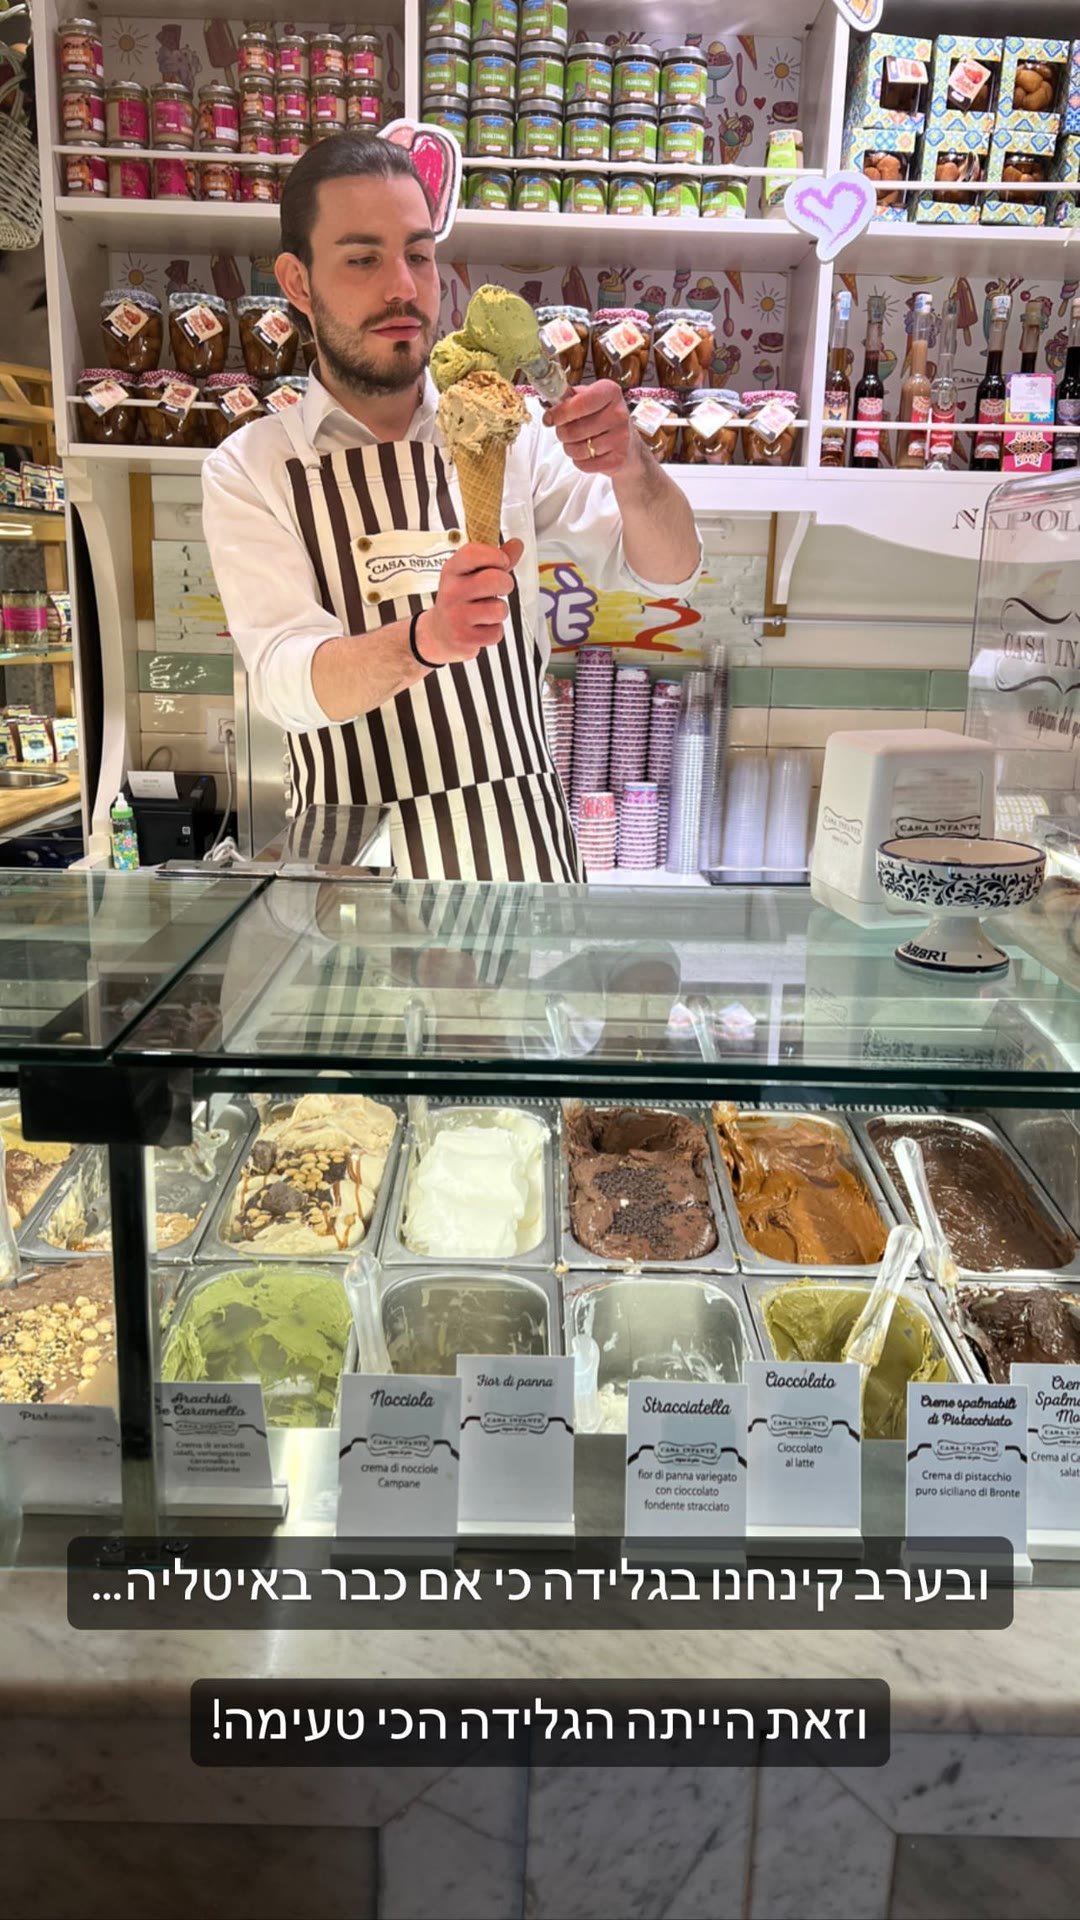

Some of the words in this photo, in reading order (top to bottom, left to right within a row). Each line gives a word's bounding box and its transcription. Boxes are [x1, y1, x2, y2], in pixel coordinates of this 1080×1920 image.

[372, 559, 406, 575] CASA
[1003, 633, 1046, 664] CASA
[1055, 638, 1080, 669] IN
[476, 1374, 501, 1387] Fior
[503, 1374, 514, 1387] di
[516, 1378, 554, 1391] panna
[765, 1370, 837, 1389] Cioccolato
[171, 1392, 232, 1404] Arachidi
[370, 1389, 435, 1408] Nocciola
[173, 1405, 246, 1416] Caramello
[642, 1396, 732, 1416] Stracciatella
[927, 1412, 939, 1425] di
[941, 1412, 1013, 1426] Pistacchiato
[777, 1442, 823, 1454] Cioccolato
[785, 1458, 794, 1468] al
[795, 1458, 815, 1468] latte
[1031, 1451, 1060, 1462] Crema
[1061, 1451, 1070, 1462] al
[361, 1464, 389, 1473] crema
[390, 1463, 400, 1473] di
[401, 1464, 439, 1474] nocciole
[638, 1469, 653, 1479] fior
[654, 1470, 664, 1480] di
[665, 1473, 694, 1482] panna
[695, 1472, 738, 1484] variegato
[921, 1470, 952, 1480] Crema
[953, 1470, 963, 1481] di
[964, 1471, 1012, 1483] pistacchio
[377, 1477, 421, 1490] Campane
[655, 1486, 672, 1495] con
[674, 1486, 720, 1496] cioccolato
[915, 1487, 938, 1499] puro
[939, 1486, 977, 1497] siciliano
[978, 1487, 988, 1497] di
[989, 1487, 1020, 1498] Bronte
[644, 1499, 686, 1511] fondente
[687, 1500, 730, 1512] stracciato
